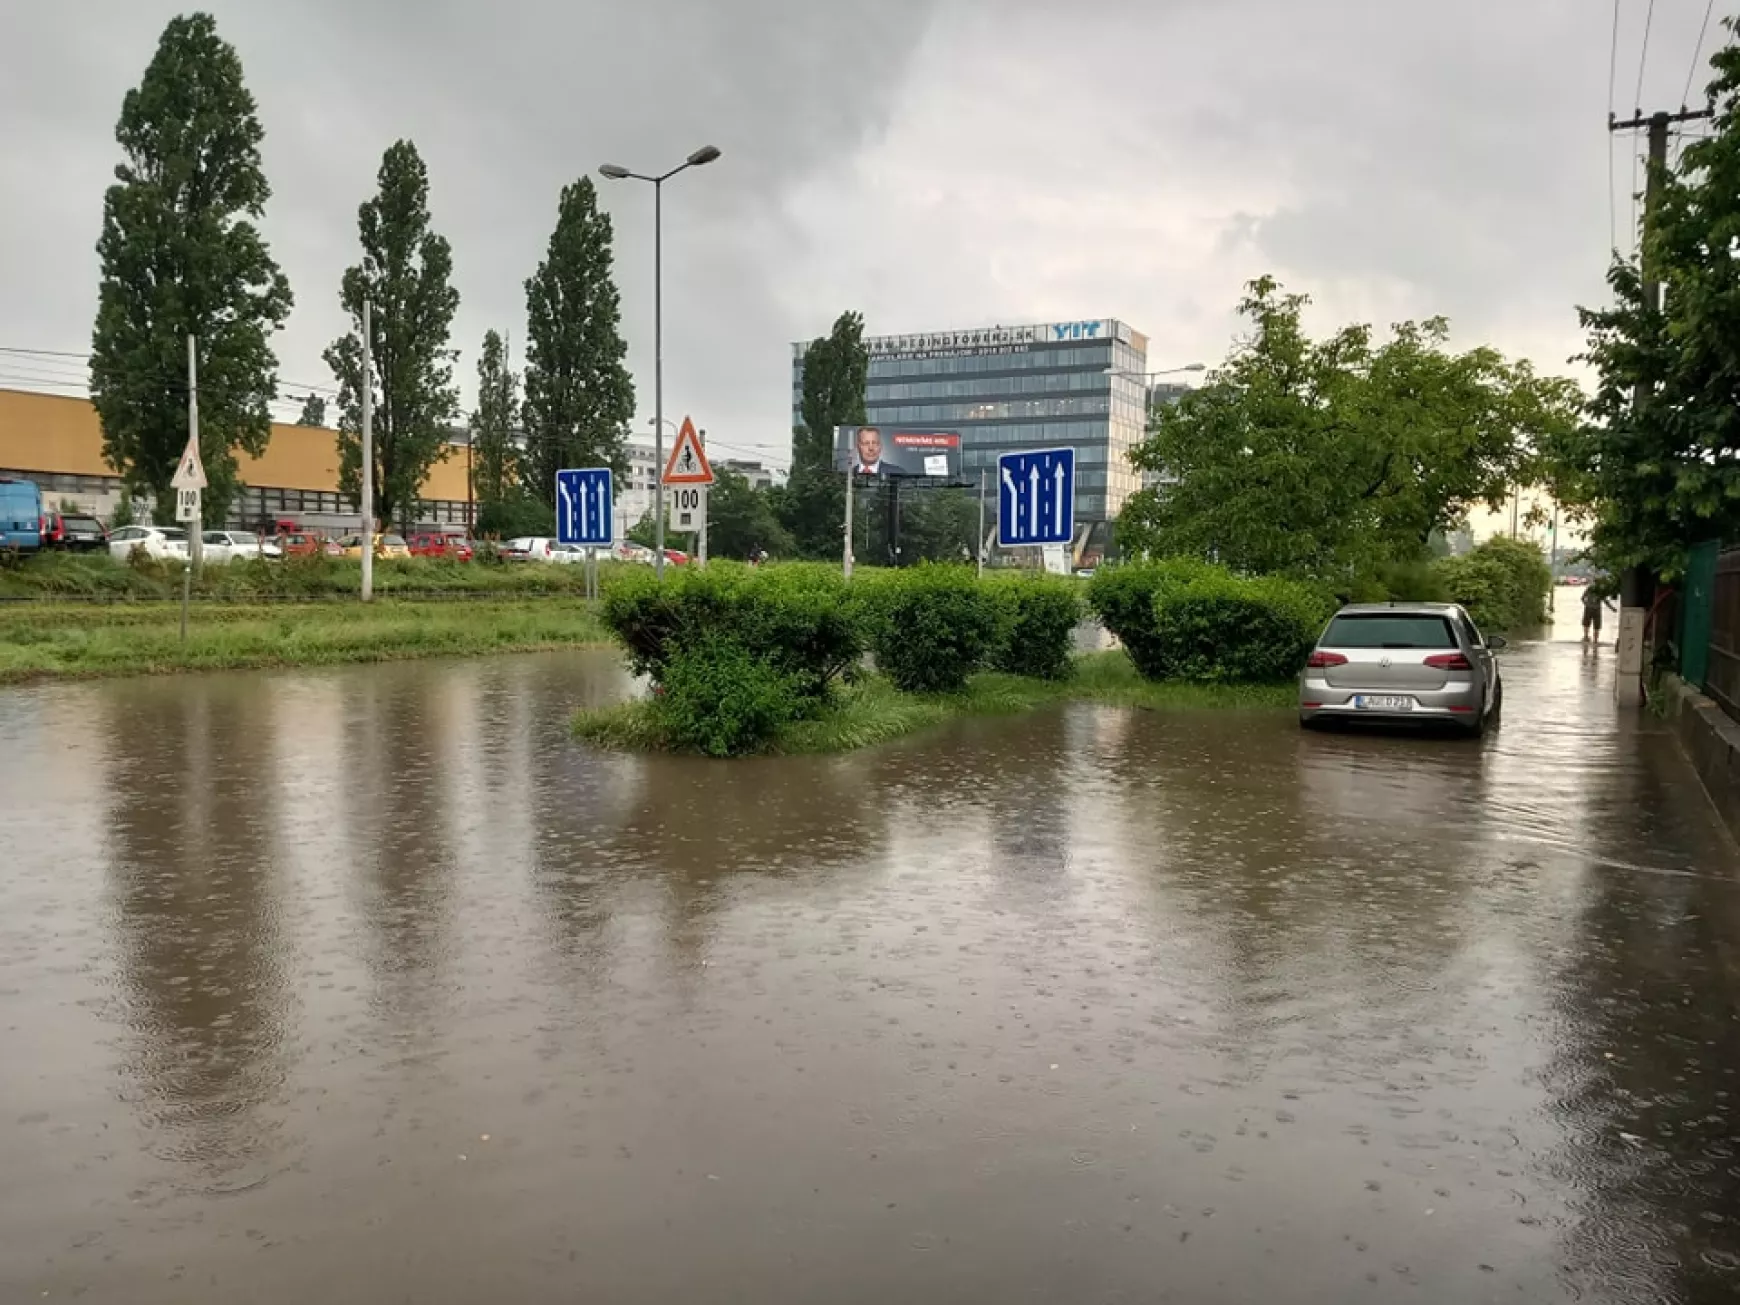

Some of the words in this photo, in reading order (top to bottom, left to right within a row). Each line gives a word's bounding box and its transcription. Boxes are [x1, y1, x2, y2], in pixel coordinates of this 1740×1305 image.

[1052, 320, 1101, 340] YIT
[179, 490, 197, 506] 100
[674, 489, 699, 509] 100
